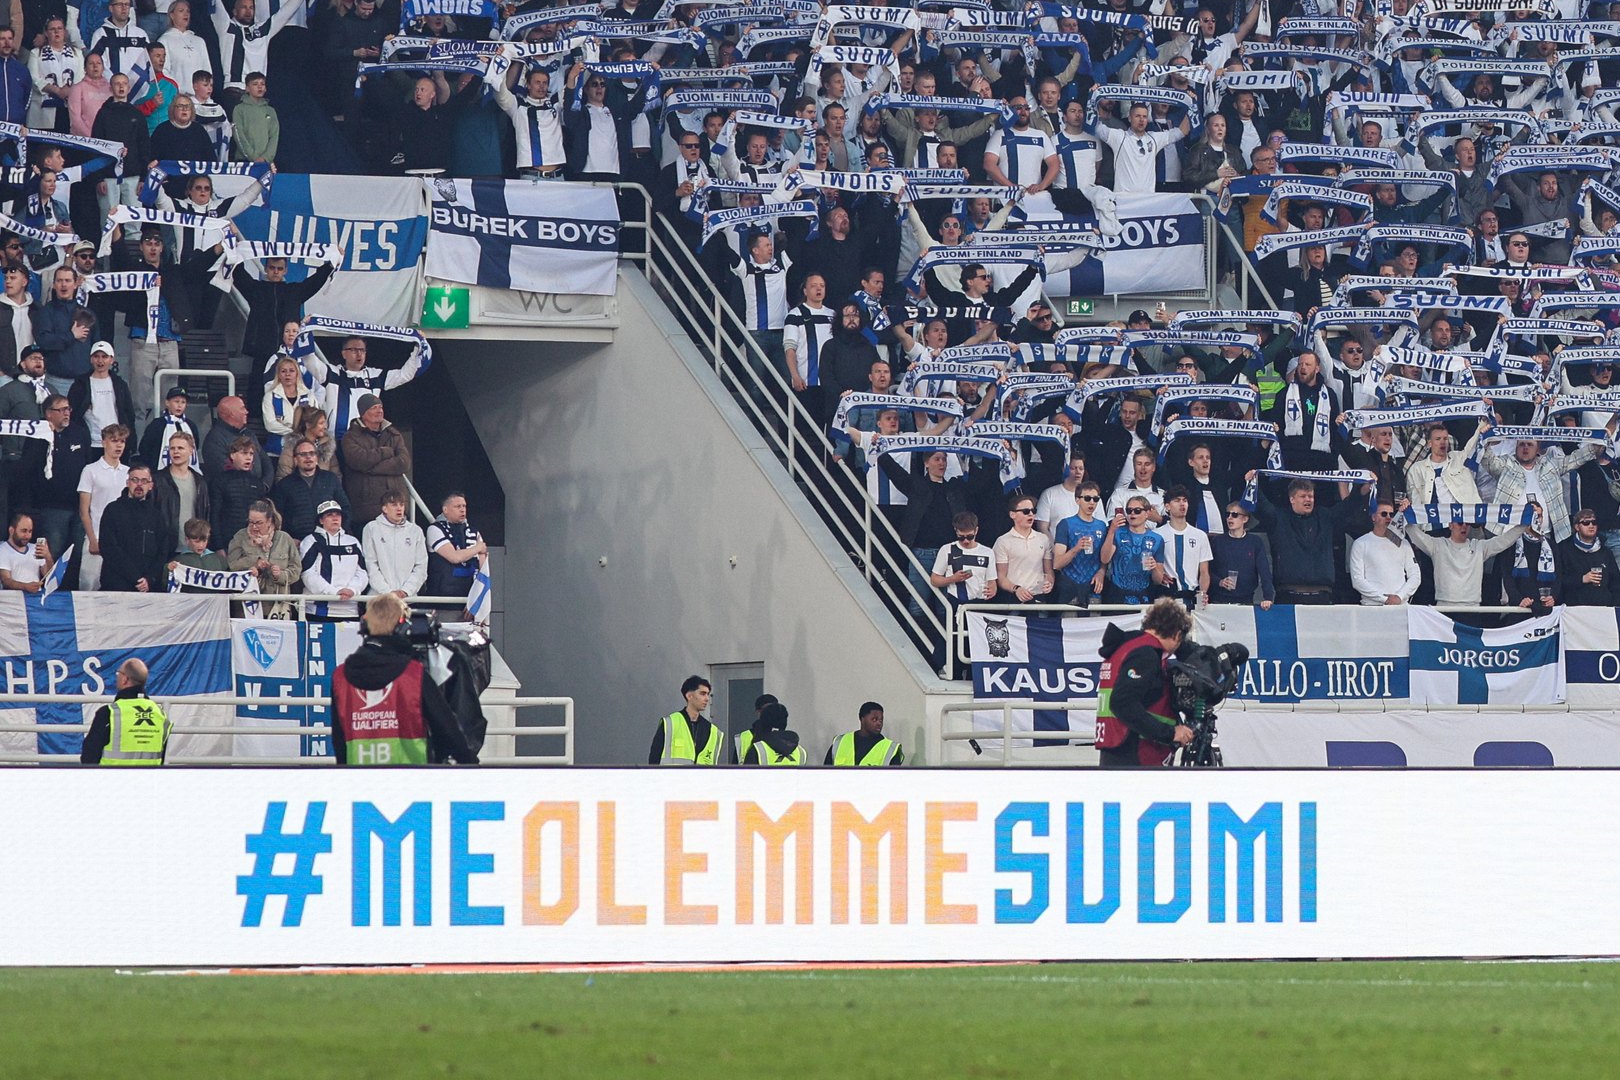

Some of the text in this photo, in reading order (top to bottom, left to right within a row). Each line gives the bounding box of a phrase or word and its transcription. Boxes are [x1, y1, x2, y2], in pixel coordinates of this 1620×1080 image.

[840, 7, 909, 25] SUOMI
[1442, 61, 1546, 74] POHJOISKAARRE
[676, 91, 772, 104] SUOMI FINLAND
[1354, 170, 1453, 183] SUOMI FINLAND
[718, 202, 804, 221] SUOMI FINLAND
[433, 207, 617, 245] BUREK BOYS
[1104, 217, 1180, 247] BOYS
[981, 234, 1092, 245] POHJOISKAARRE
[935, 250, 1023, 259] SUOMI FINLAND
[519, 291, 572, 314] WC
[1186, 310, 1280, 320] SUOMI FINLAND
[317, 318, 414, 335] SUOMI FINLAND
[1408, 382, 1519, 398] POHJOISKAARRE
[849, 393, 955, 409] POHJOISKAARRE
[1369, 404, 1478, 421] POHJOISKAARRE
[983, 667, 1100, 693] KAUS
[352, 712, 396, 720] EUROPEAN
[358, 743, 391, 764] HB
[235, 800, 1319, 927] #MEOLEMMESUOMI
